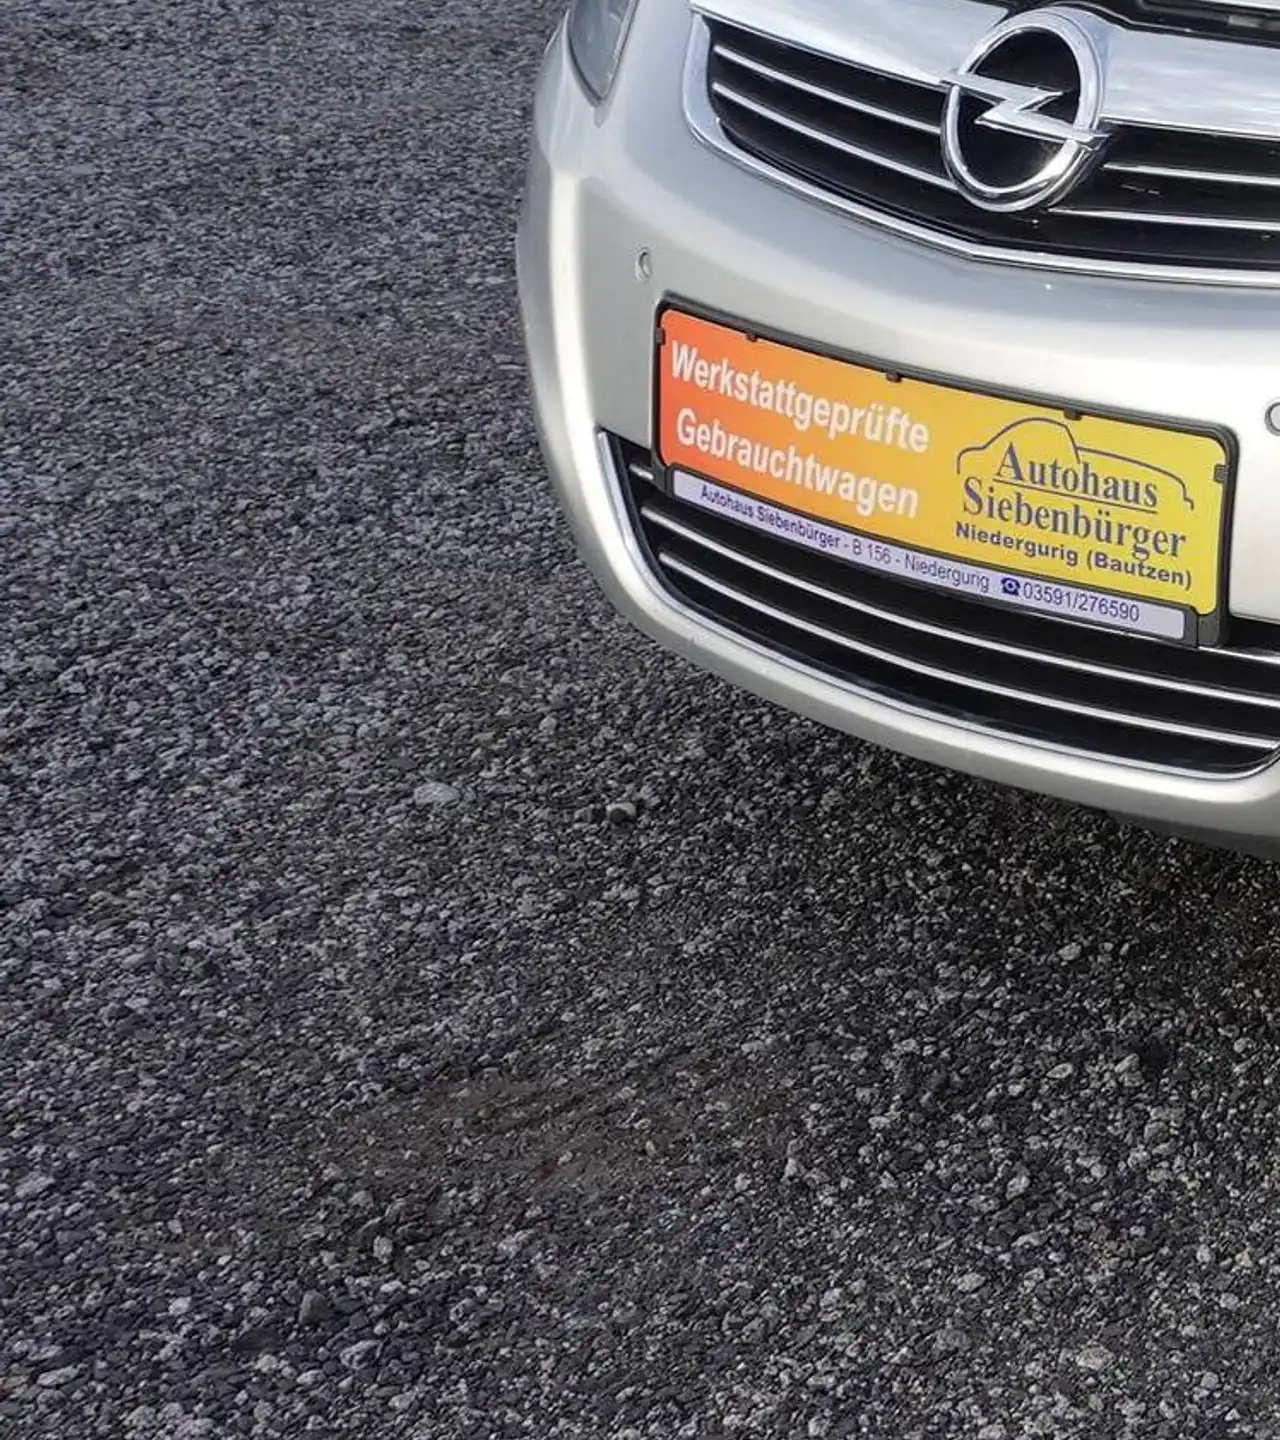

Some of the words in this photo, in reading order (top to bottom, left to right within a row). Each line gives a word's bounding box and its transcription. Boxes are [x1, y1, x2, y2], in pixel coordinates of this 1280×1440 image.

[670, 340, 930, 453] Werkstattgeprüfte
[676, 407, 919, 518] Gebrauchtwagen
[997, 442, 1158, 509] Autohaus
[701, 485, 754, 519] Autohaus
[757, 505, 841, 549] Siebenbürger
[852, 538, 862, 556] B
[867, 543, 891, 565] 156
[905, 554, 989, 594] Niedergurig
[1023, 581, 1140, 623] 03591/276590
[955, 521, 1078, 567] Niedergurig
[1086, 550, 1192, 589] (Bautzen)
[963, 476, 1187, 562] Siebenbürger
